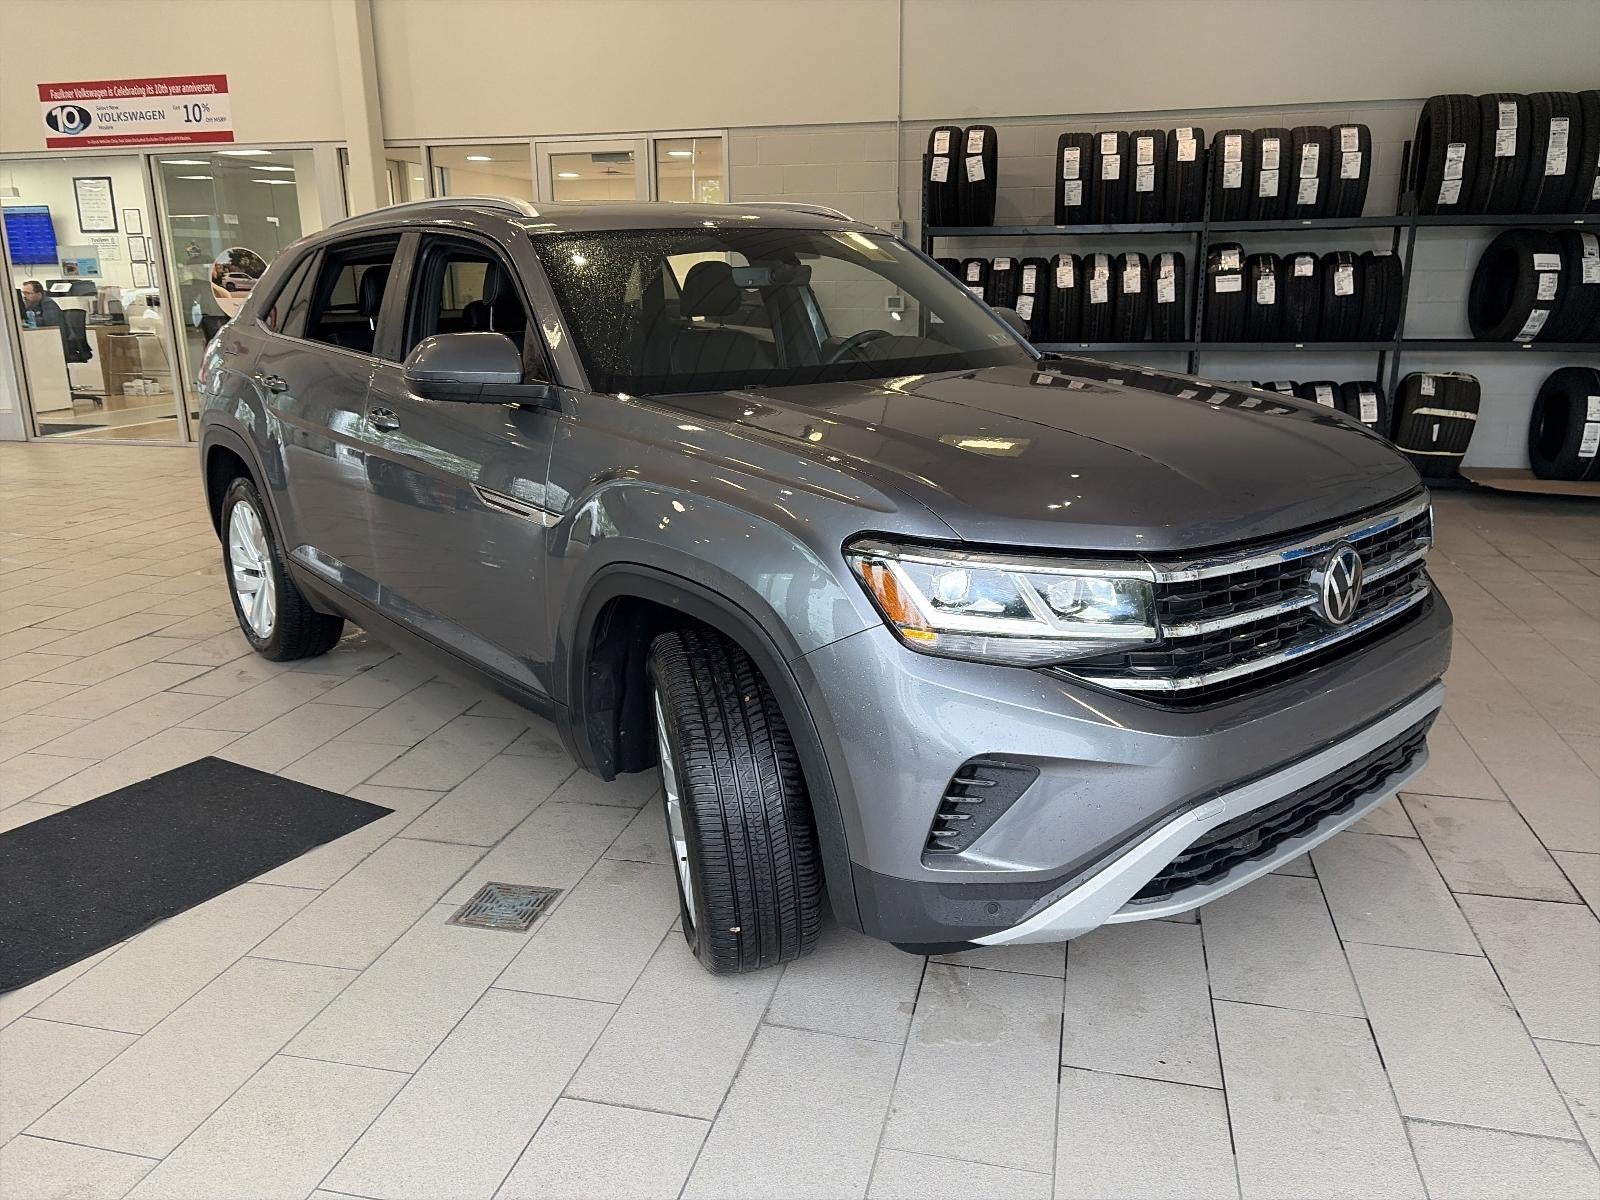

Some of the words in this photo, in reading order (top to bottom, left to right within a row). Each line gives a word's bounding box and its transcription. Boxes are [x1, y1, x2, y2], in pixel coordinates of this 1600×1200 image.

[49, 89, 74, 100] Faulkner
[74, 87, 107, 99] Volkswagen
[107, 86, 113, 96] is
[113, 85, 146, 98] Celebrating
[154, 83, 168, 94] 10th
[168, 84, 181, 96] year
[181, 82, 217, 95] anniversary.
[51, 106, 80, 132] 10
[96, 110, 166, 122] VOLKSWAGEN
